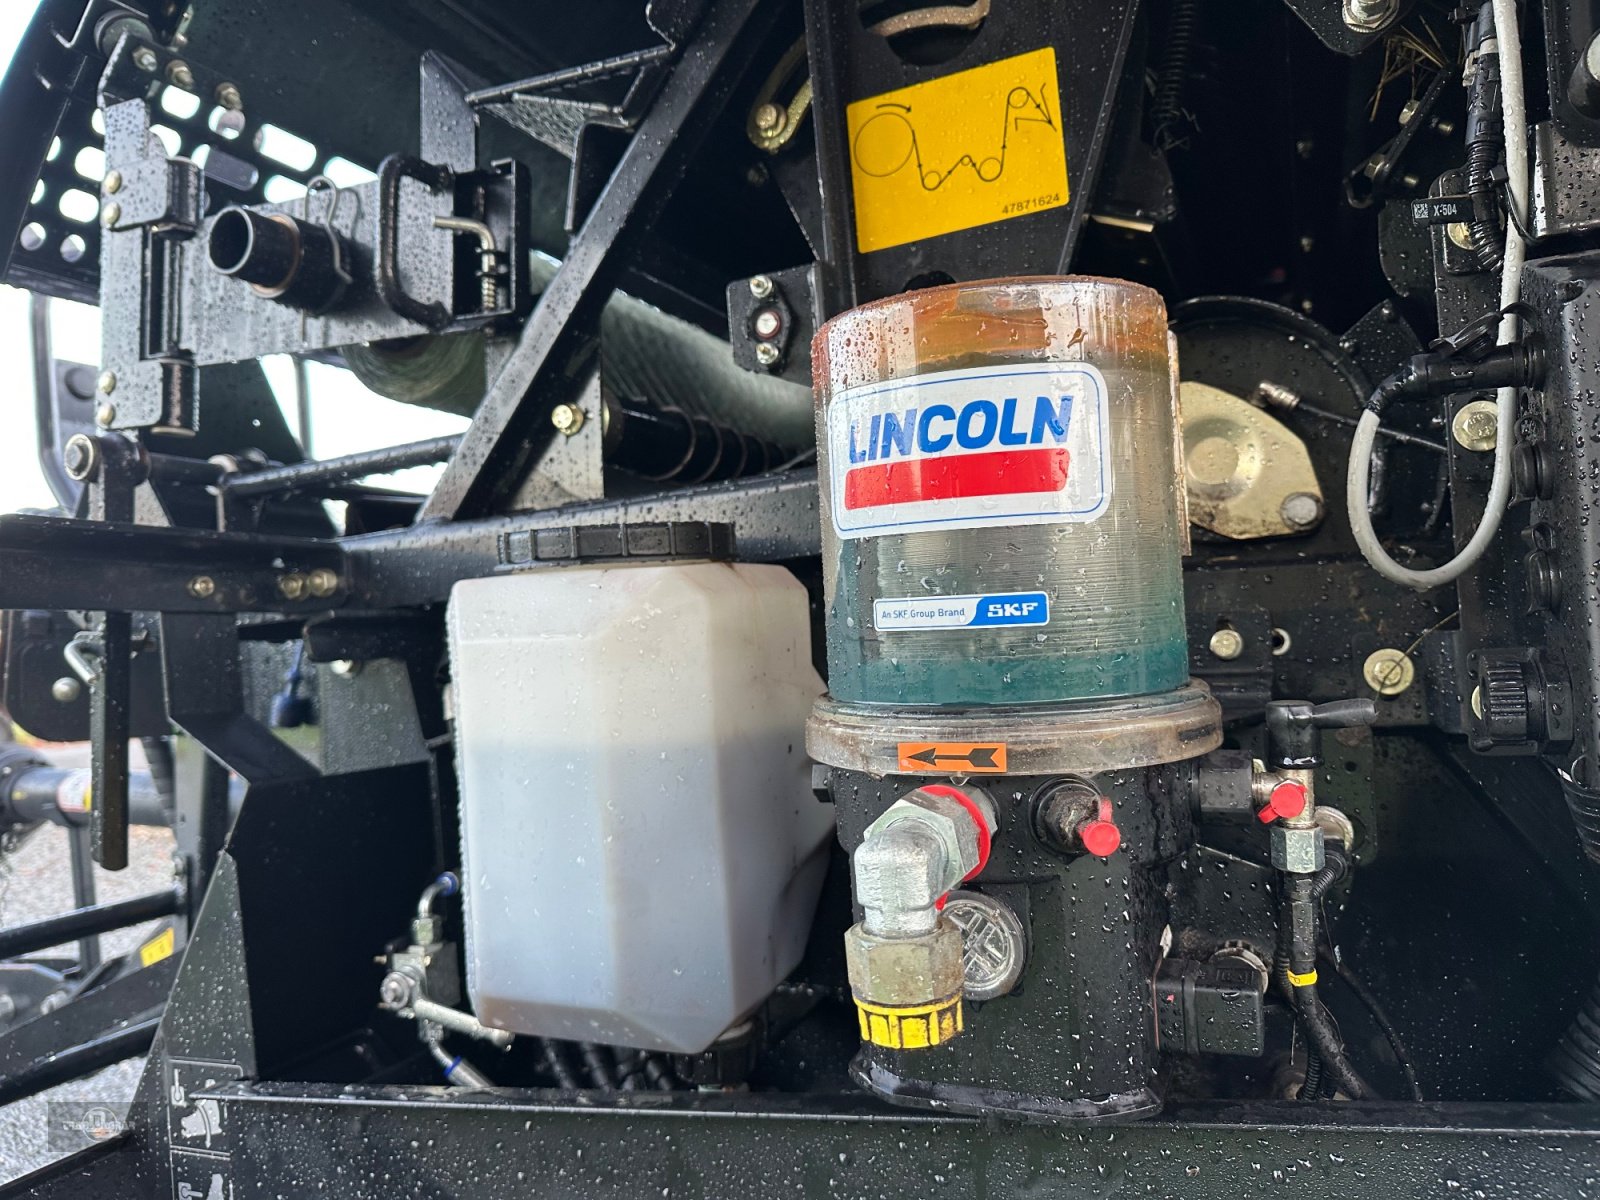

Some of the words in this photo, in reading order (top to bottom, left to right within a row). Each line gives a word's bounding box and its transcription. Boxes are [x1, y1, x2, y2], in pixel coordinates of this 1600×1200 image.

[1002, 193, 1060, 214] 47871624
[850, 395, 1074, 464] LINCOLN
[882, 610, 892, 619] An
[893, 609, 908, 619] SKF
[910, 609, 935, 619] Group
[938, 608, 965, 617] Brand
[987, 602, 1039, 618] SKF
